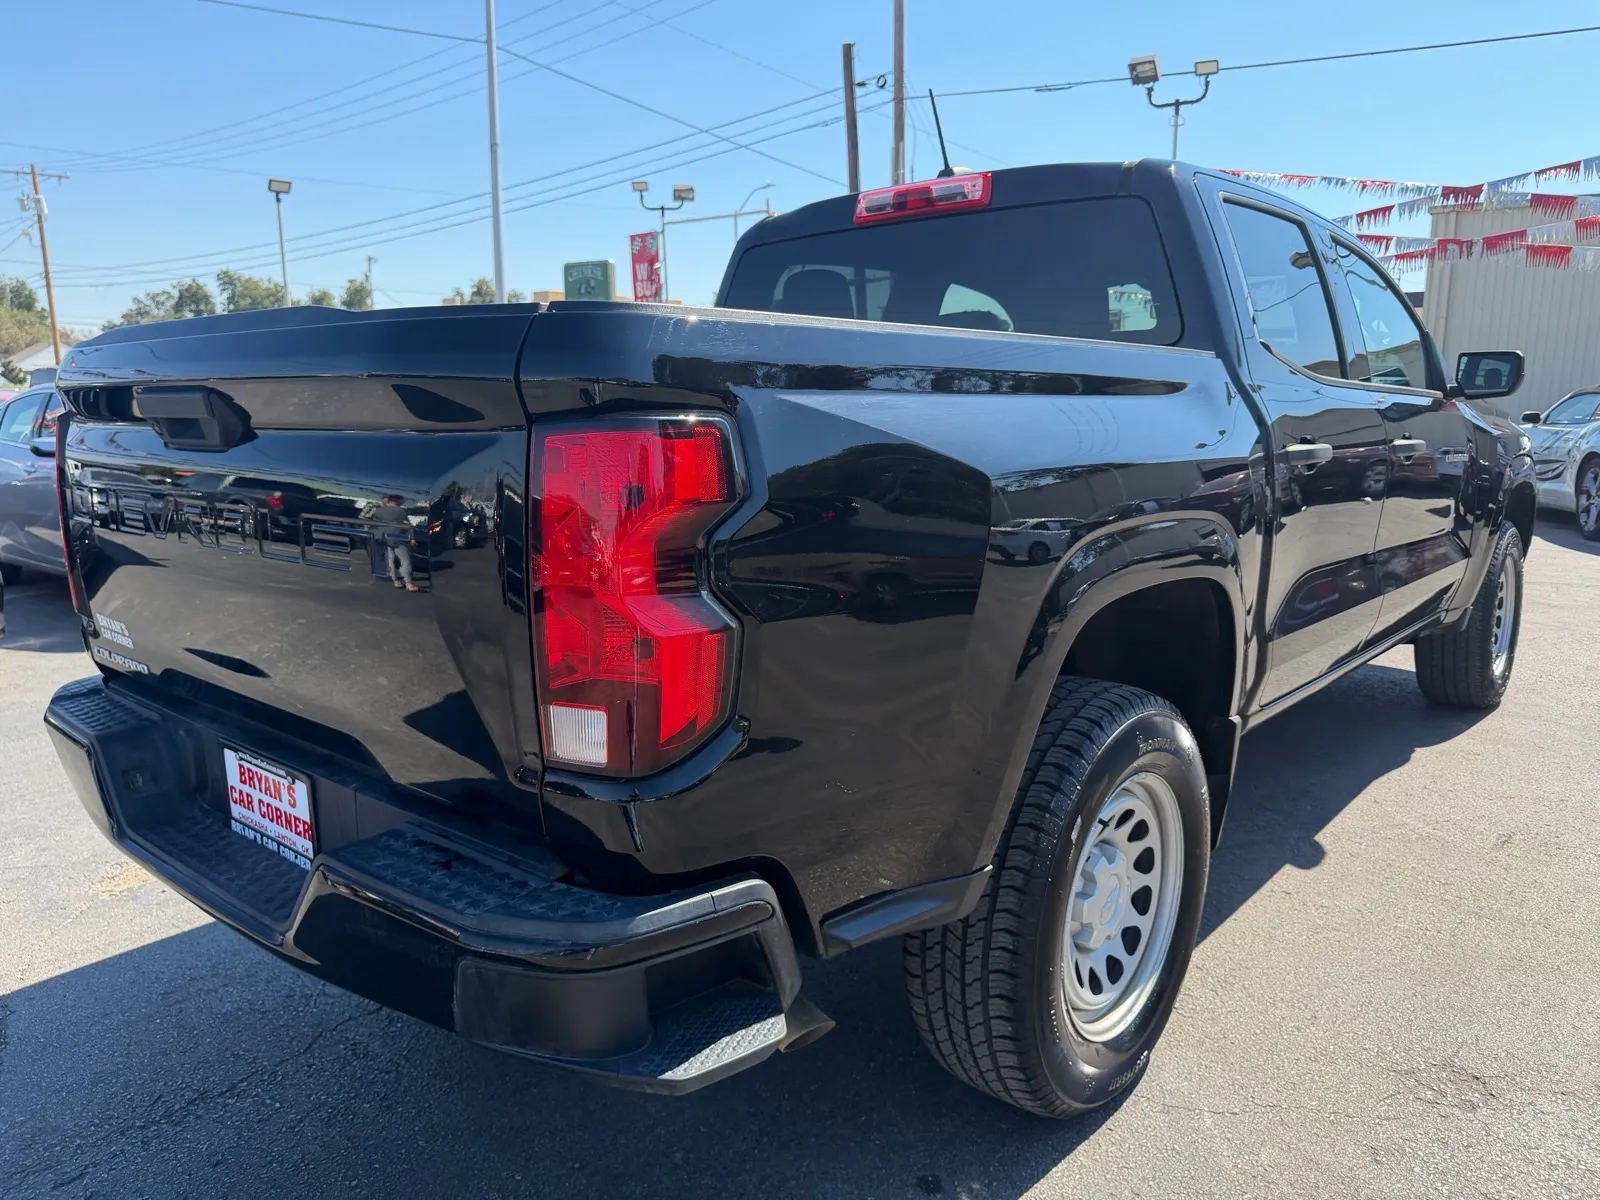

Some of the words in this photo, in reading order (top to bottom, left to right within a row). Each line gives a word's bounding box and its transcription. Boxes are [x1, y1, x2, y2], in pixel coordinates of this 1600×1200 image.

[94, 646, 149, 674] COLORADO
[237, 762, 297, 809] BRYAN'S
[229, 785, 255, 814] CAR
[257, 798, 313, 842] CORNER
[238, 812, 269, 833] CHICKASHA
[231, 819, 262, 845] BRYAN'S
[262, 835, 279, 854] CAR
